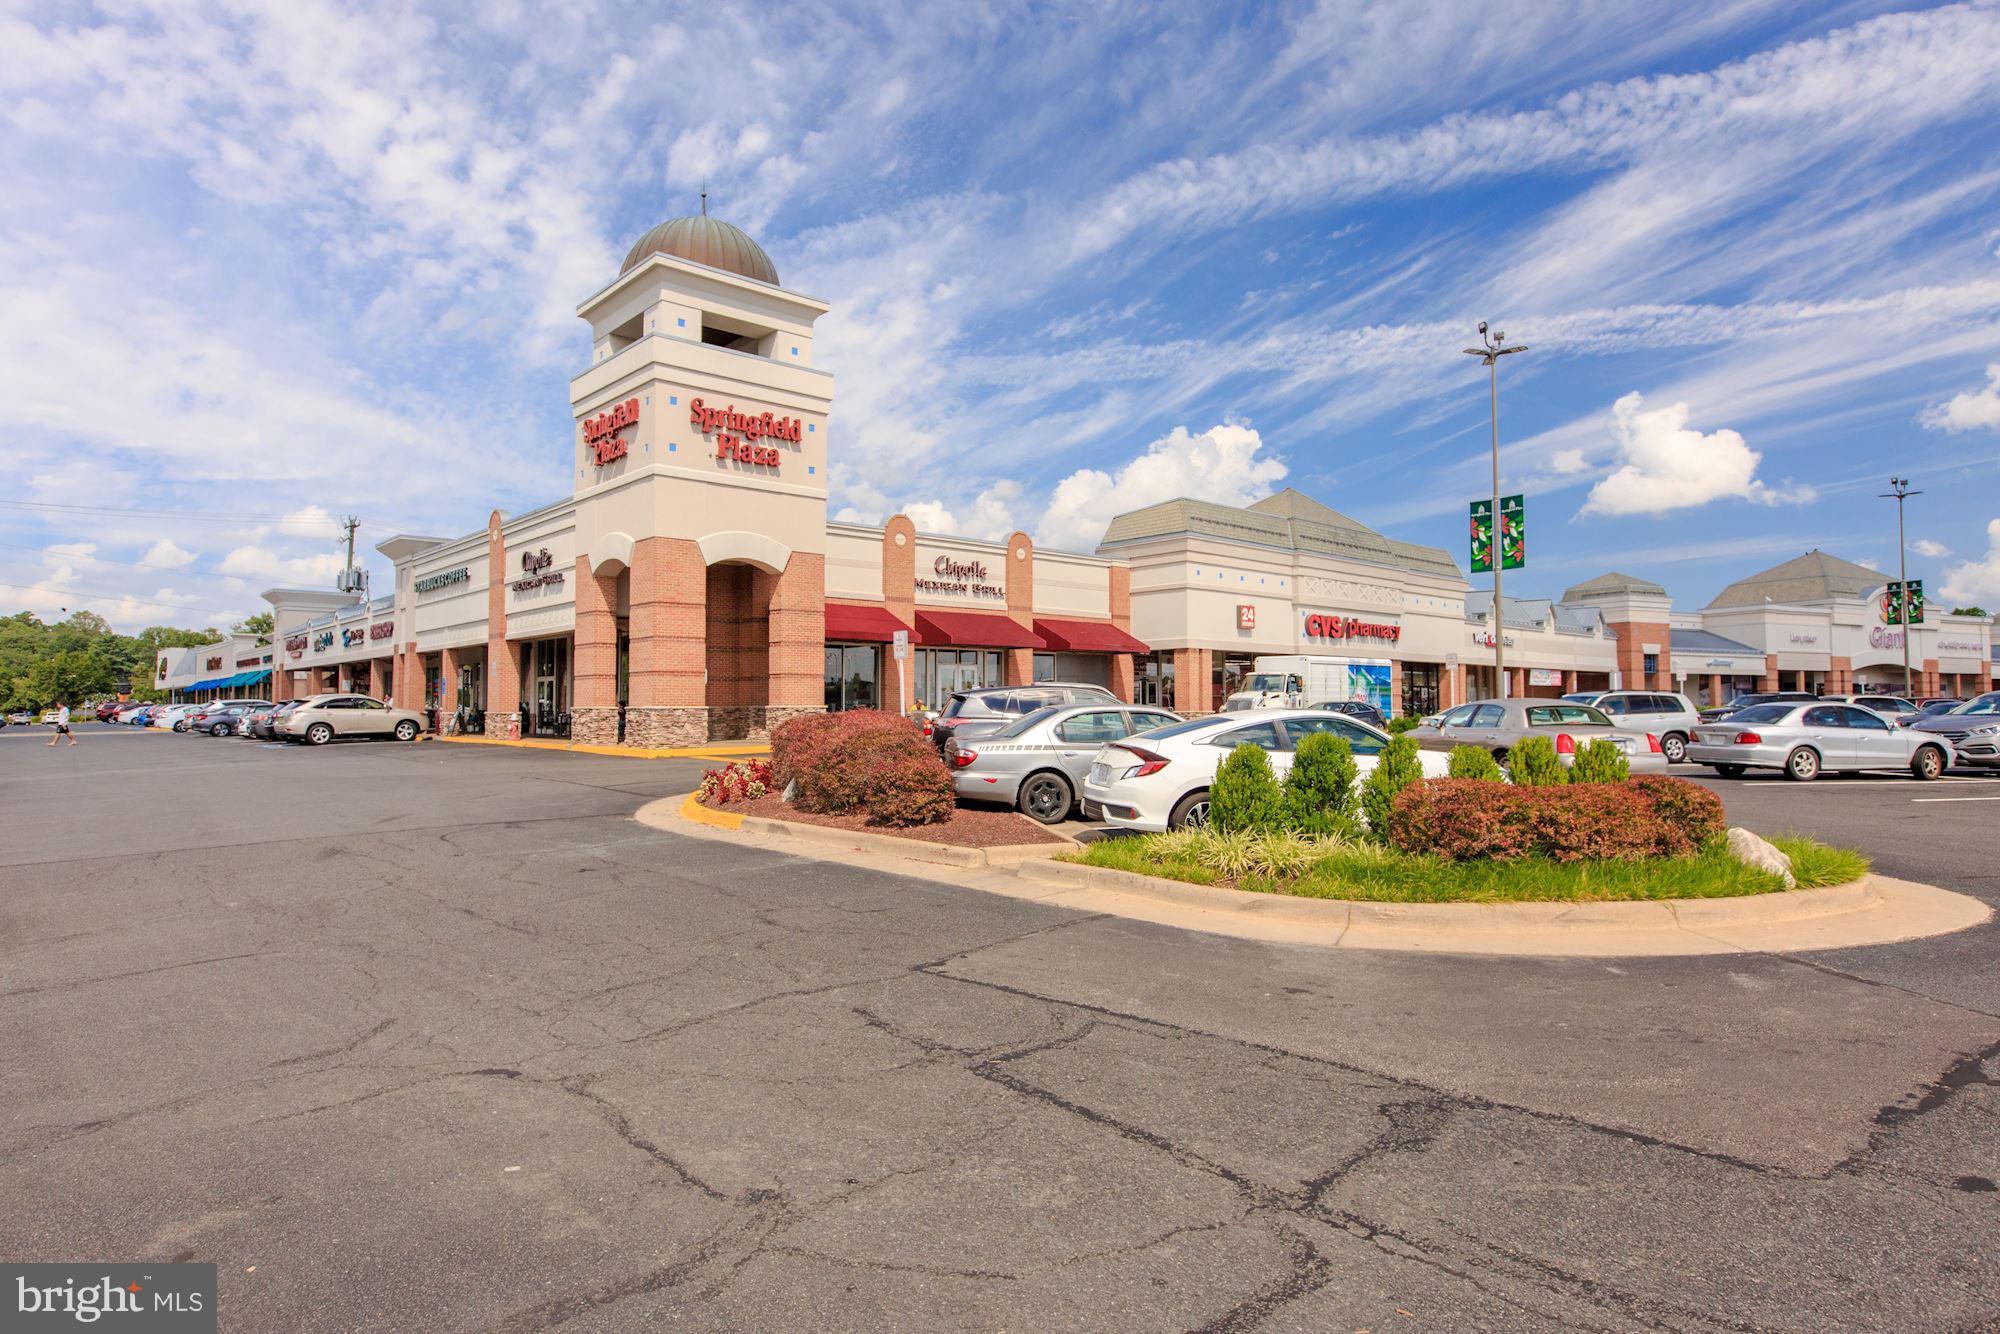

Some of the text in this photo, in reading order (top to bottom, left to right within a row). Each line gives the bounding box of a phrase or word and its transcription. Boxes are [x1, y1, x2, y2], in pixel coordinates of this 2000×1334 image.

[690, 397, 803, 443] Springfield
[716, 433, 781, 468] Plaza
[934, 555, 987, 580] Chipotle
[915, 578, 1004, 596] MEXICAN GRILL
[1241, 607, 1254, 622] 24
